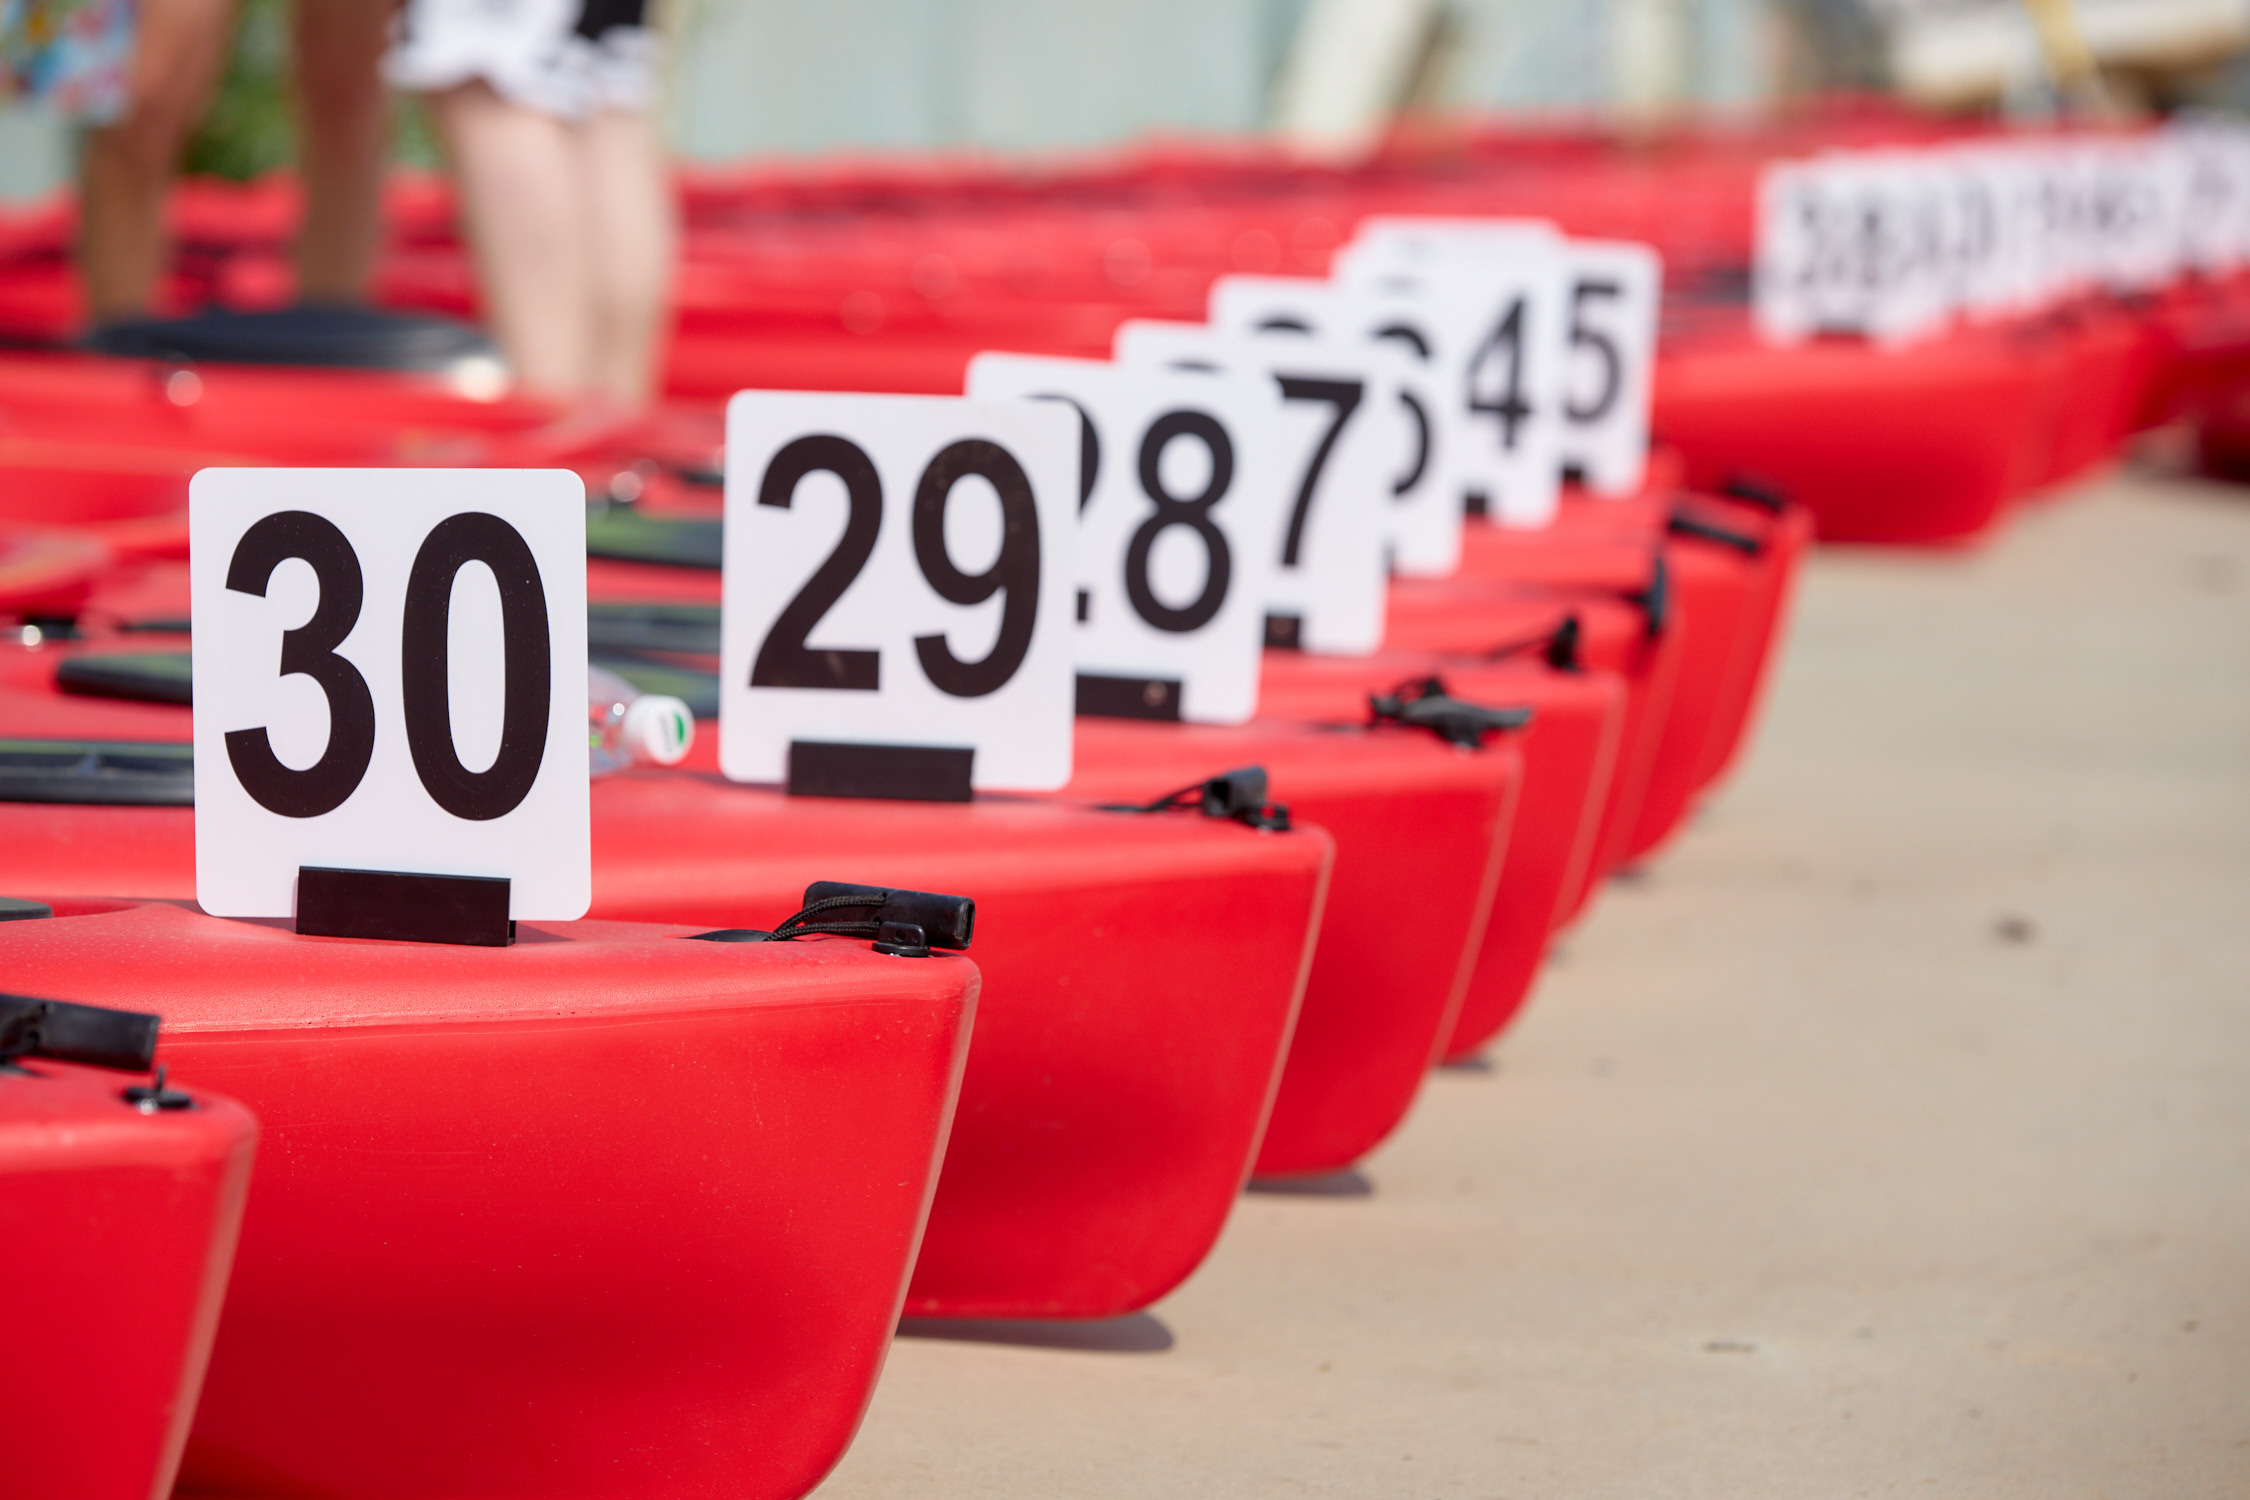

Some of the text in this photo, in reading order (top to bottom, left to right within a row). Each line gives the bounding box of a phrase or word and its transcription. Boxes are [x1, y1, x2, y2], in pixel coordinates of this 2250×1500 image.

[1464, 294, 1537, 452] 4
[1563, 277, 1624, 427] 5
[224, 510, 551, 821] 30
[750, 434, 1041, 698] 29
